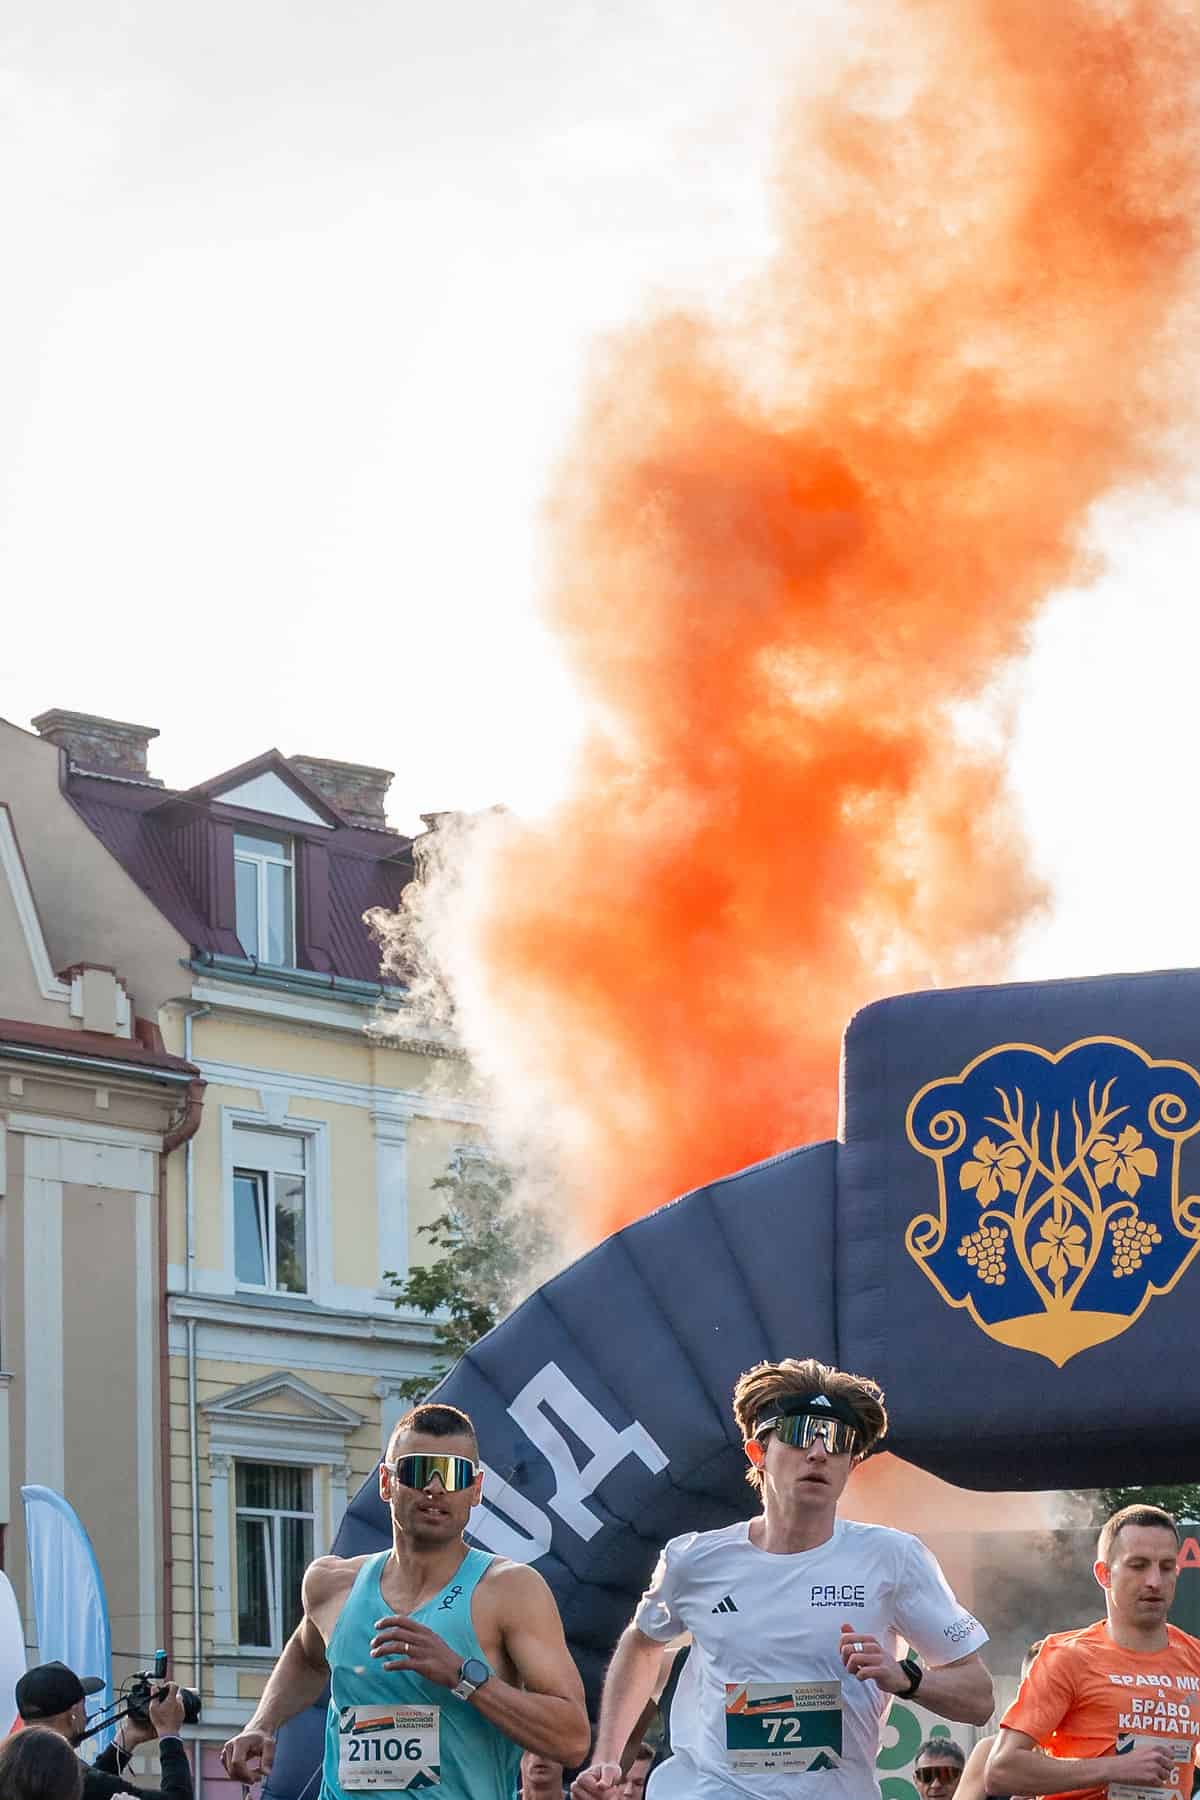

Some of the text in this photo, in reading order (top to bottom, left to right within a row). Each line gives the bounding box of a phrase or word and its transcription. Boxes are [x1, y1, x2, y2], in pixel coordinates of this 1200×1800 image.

[1108, 1674, 1200, 1692] БРАВО МК
[1157, 1688, 1166, 1698] &
[1131, 1697, 1190, 1718] БРАВО
[761, 1717, 802, 1743] 72
[1118, 1713, 1200, 1737] КАРПАТИ
[347, 1738, 423, 1761] 21106
[1162, 1766, 1180, 1785] 6
